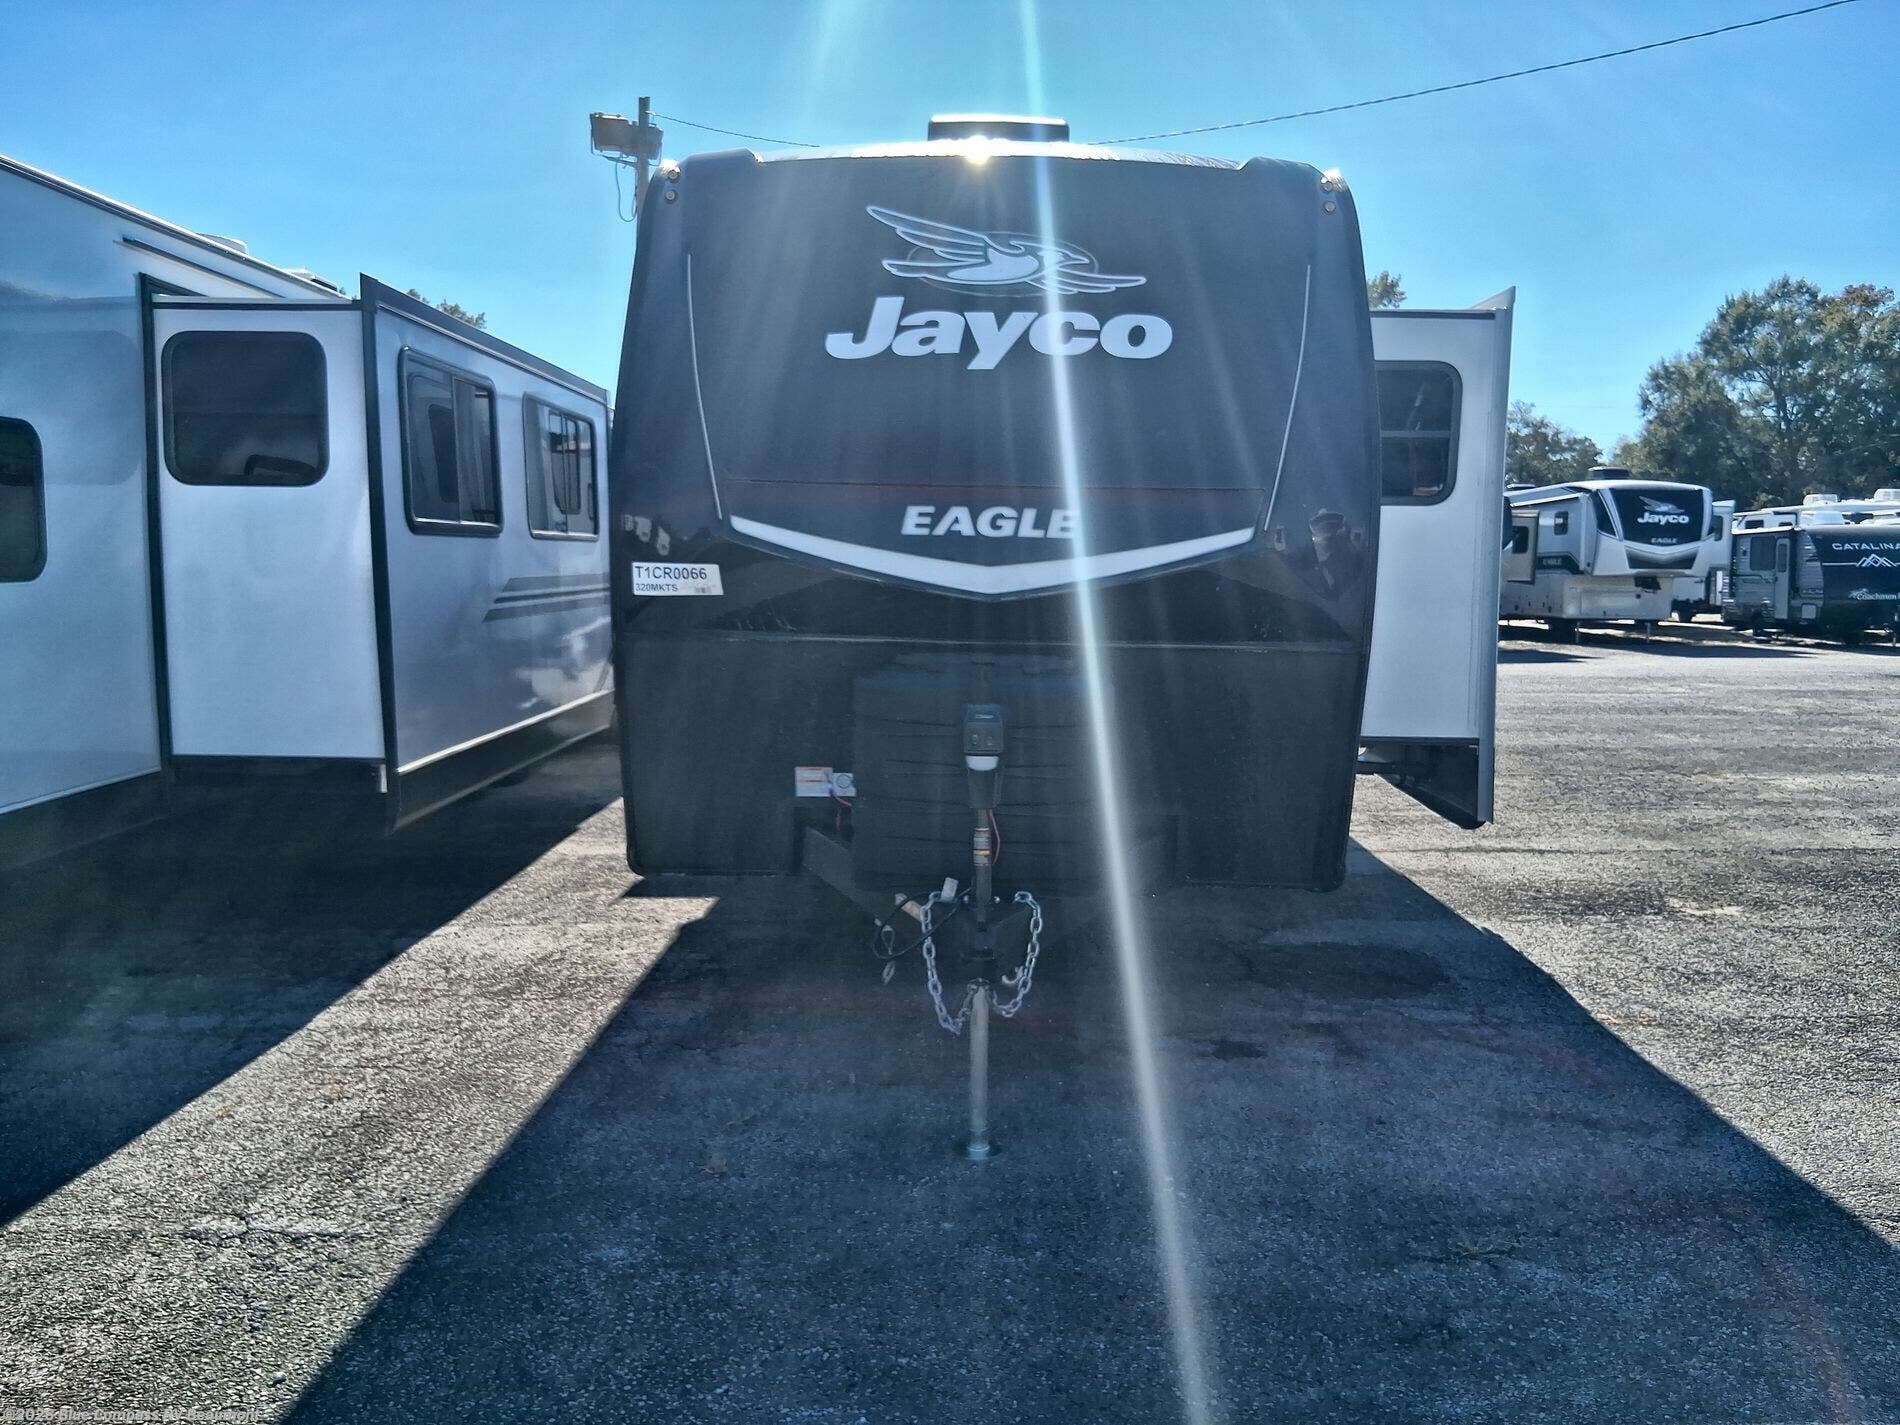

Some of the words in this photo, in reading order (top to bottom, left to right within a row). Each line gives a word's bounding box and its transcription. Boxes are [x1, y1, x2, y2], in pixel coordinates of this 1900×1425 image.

[825, 296, 1174, 370] Jayco
[901, 504, 1081, 539] EAGLE
[1637, 511, 1690, 525] Jayco
[635, 566, 708, 580] T1CR0066
[635, 583, 679, 592] 320MKTS
